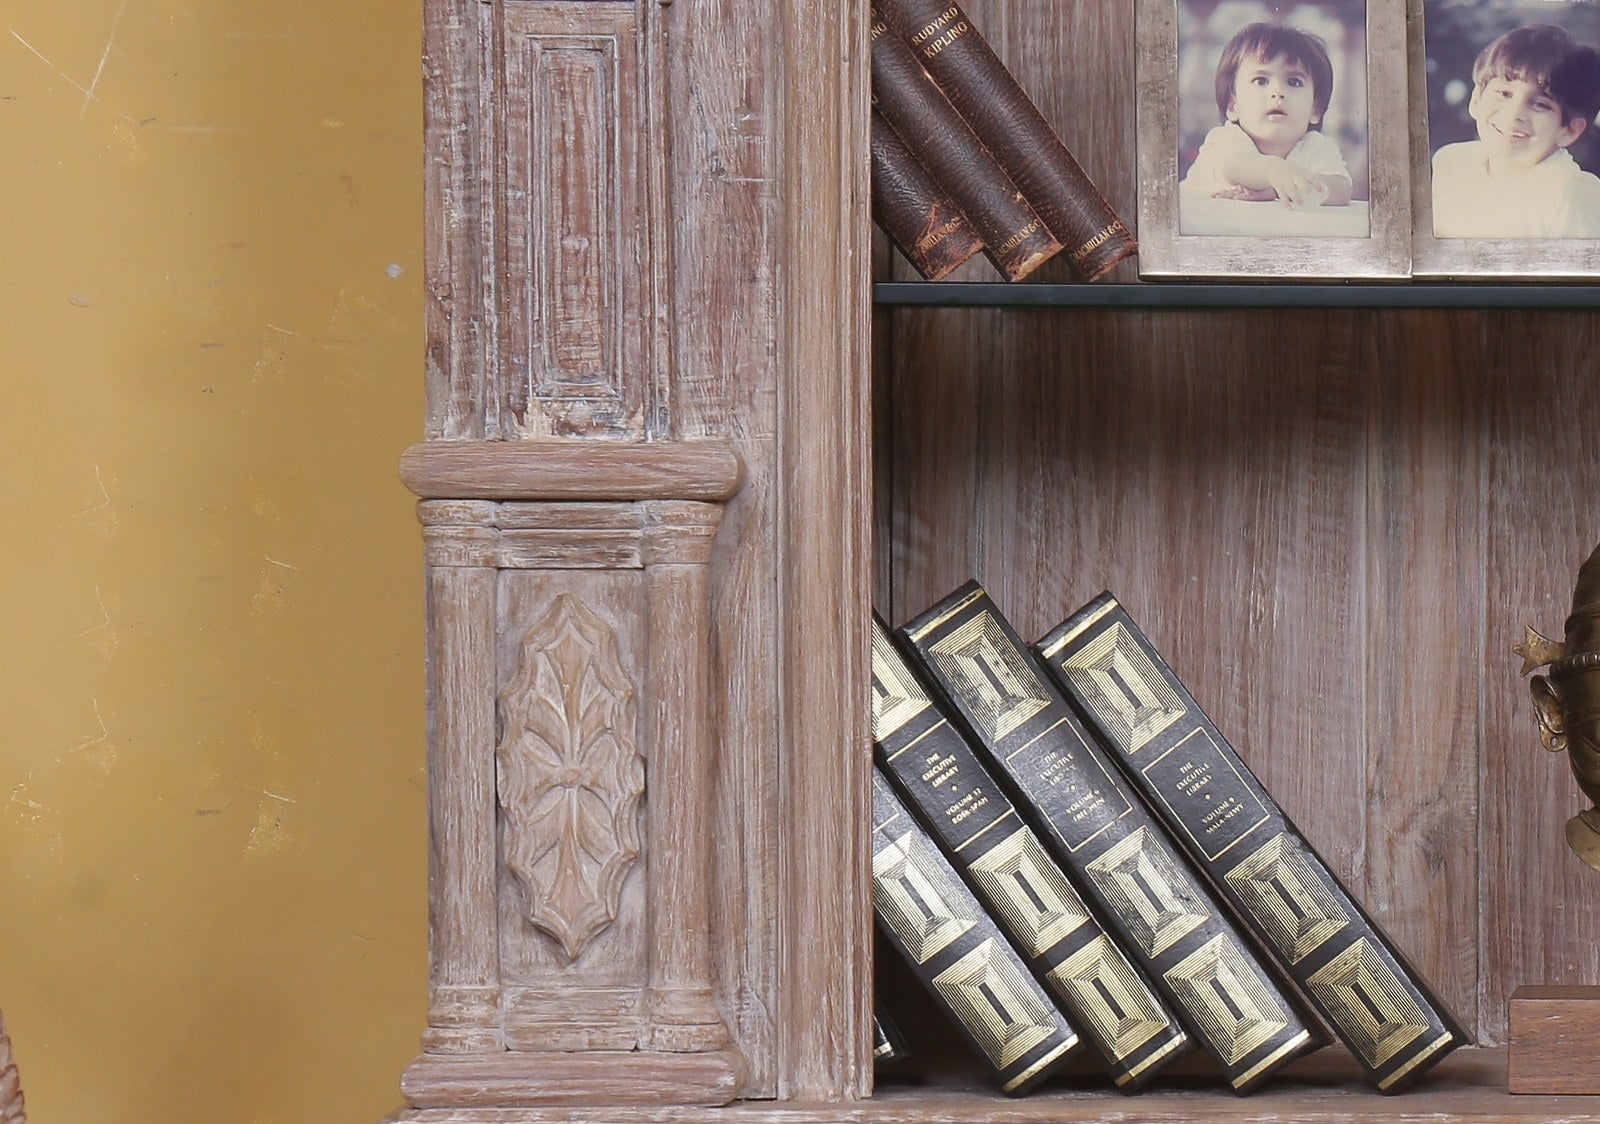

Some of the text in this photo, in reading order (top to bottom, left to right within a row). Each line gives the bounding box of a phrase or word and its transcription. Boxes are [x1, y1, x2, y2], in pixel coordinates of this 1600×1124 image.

[910, 5, 959, 45] RUDYARD
[920, 753, 957, 781] EXECUTIVE
[925, 752, 940, 765] THE
[1178, 761, 1193, 774] THE
[931, 764, 960, 788] LIBRARY
[1175, 762, 1211, 790] EXECUTIVE
[1185, 773, 1213, 796] LIBRARY
[944, 793, 973, 816] VOLUME
[1200, 801, 1229, 824] VOLUME
